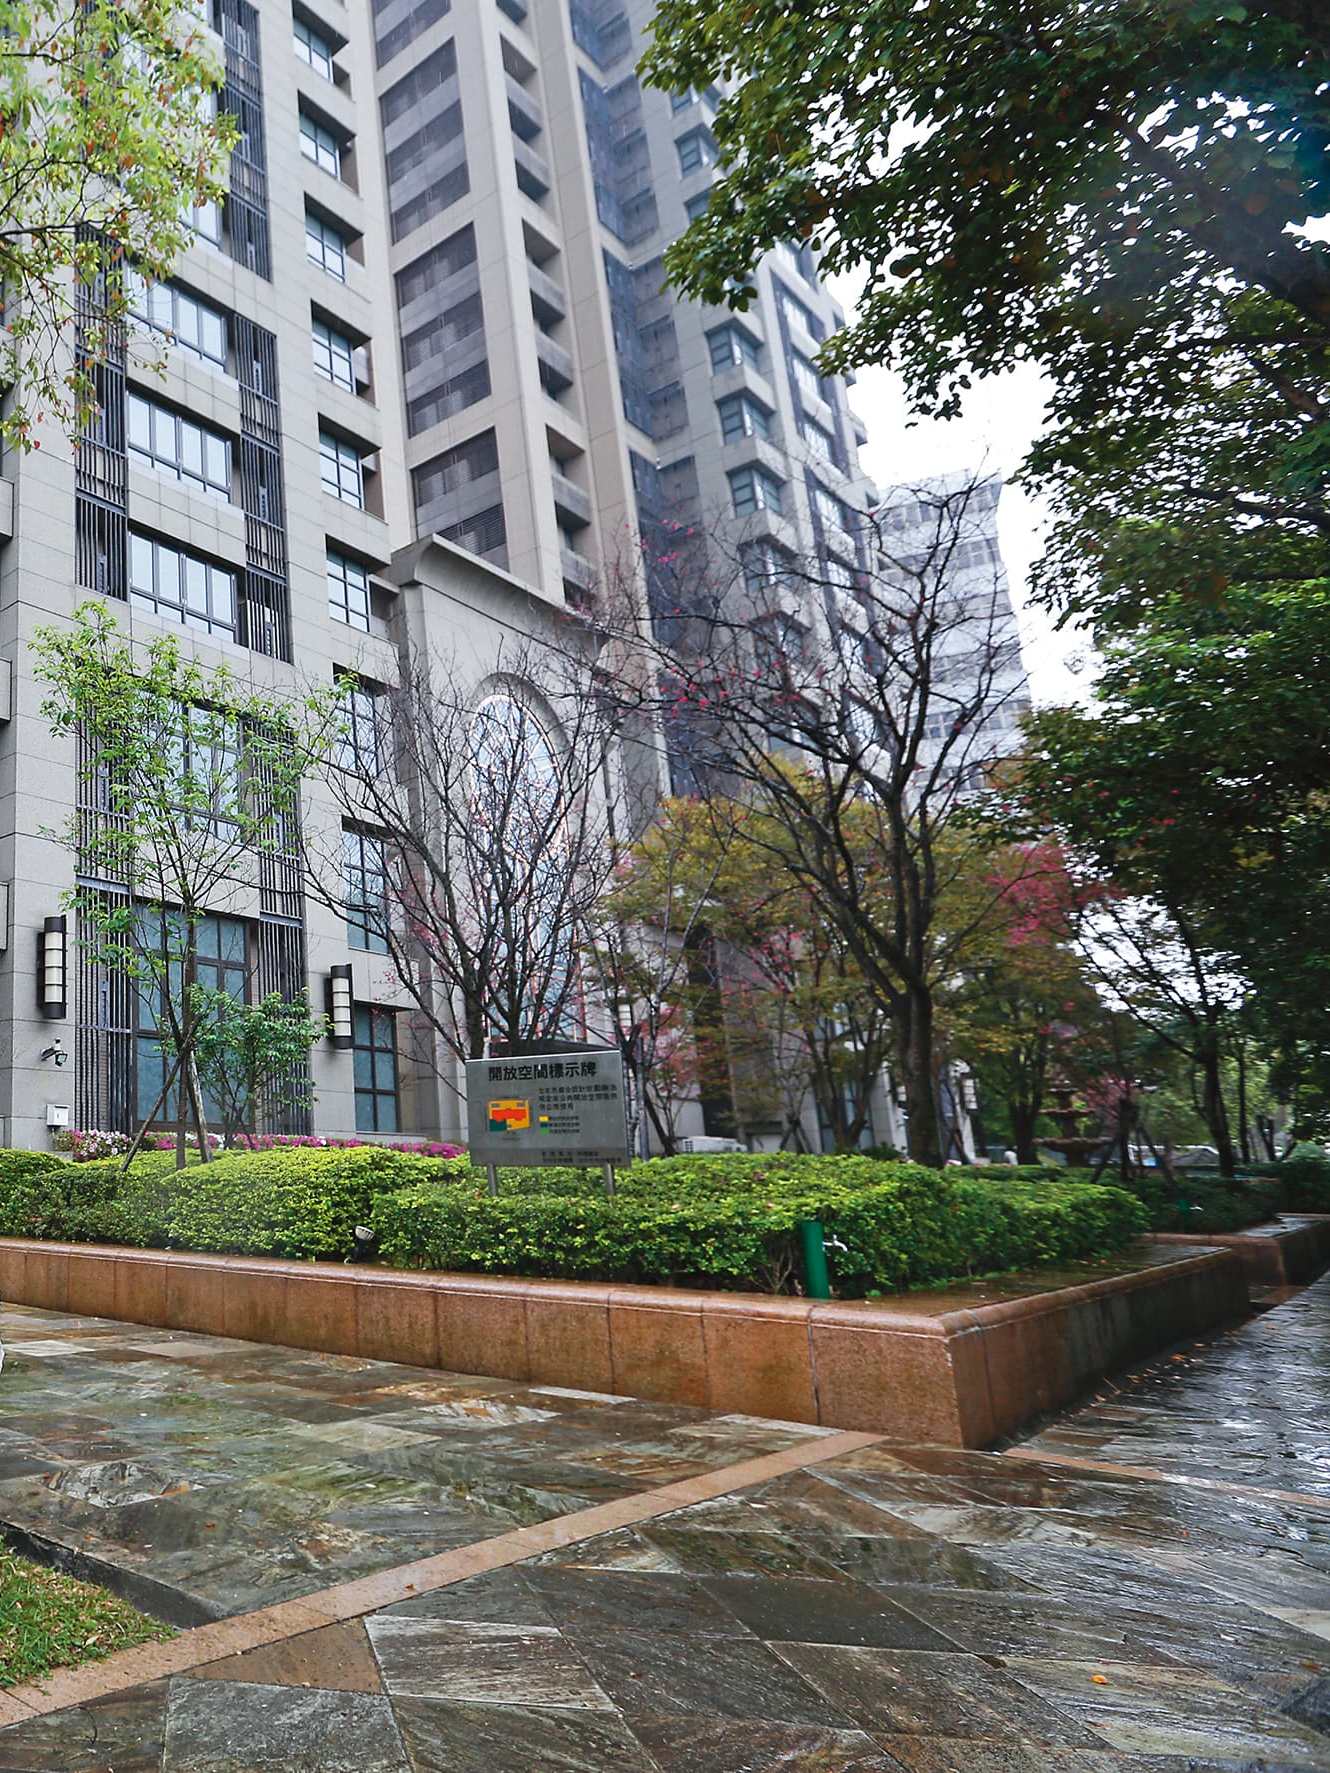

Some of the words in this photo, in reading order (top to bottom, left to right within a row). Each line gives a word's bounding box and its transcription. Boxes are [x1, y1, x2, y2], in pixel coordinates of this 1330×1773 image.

[488, 1061, 597, 1082] 開放空間標示牌
